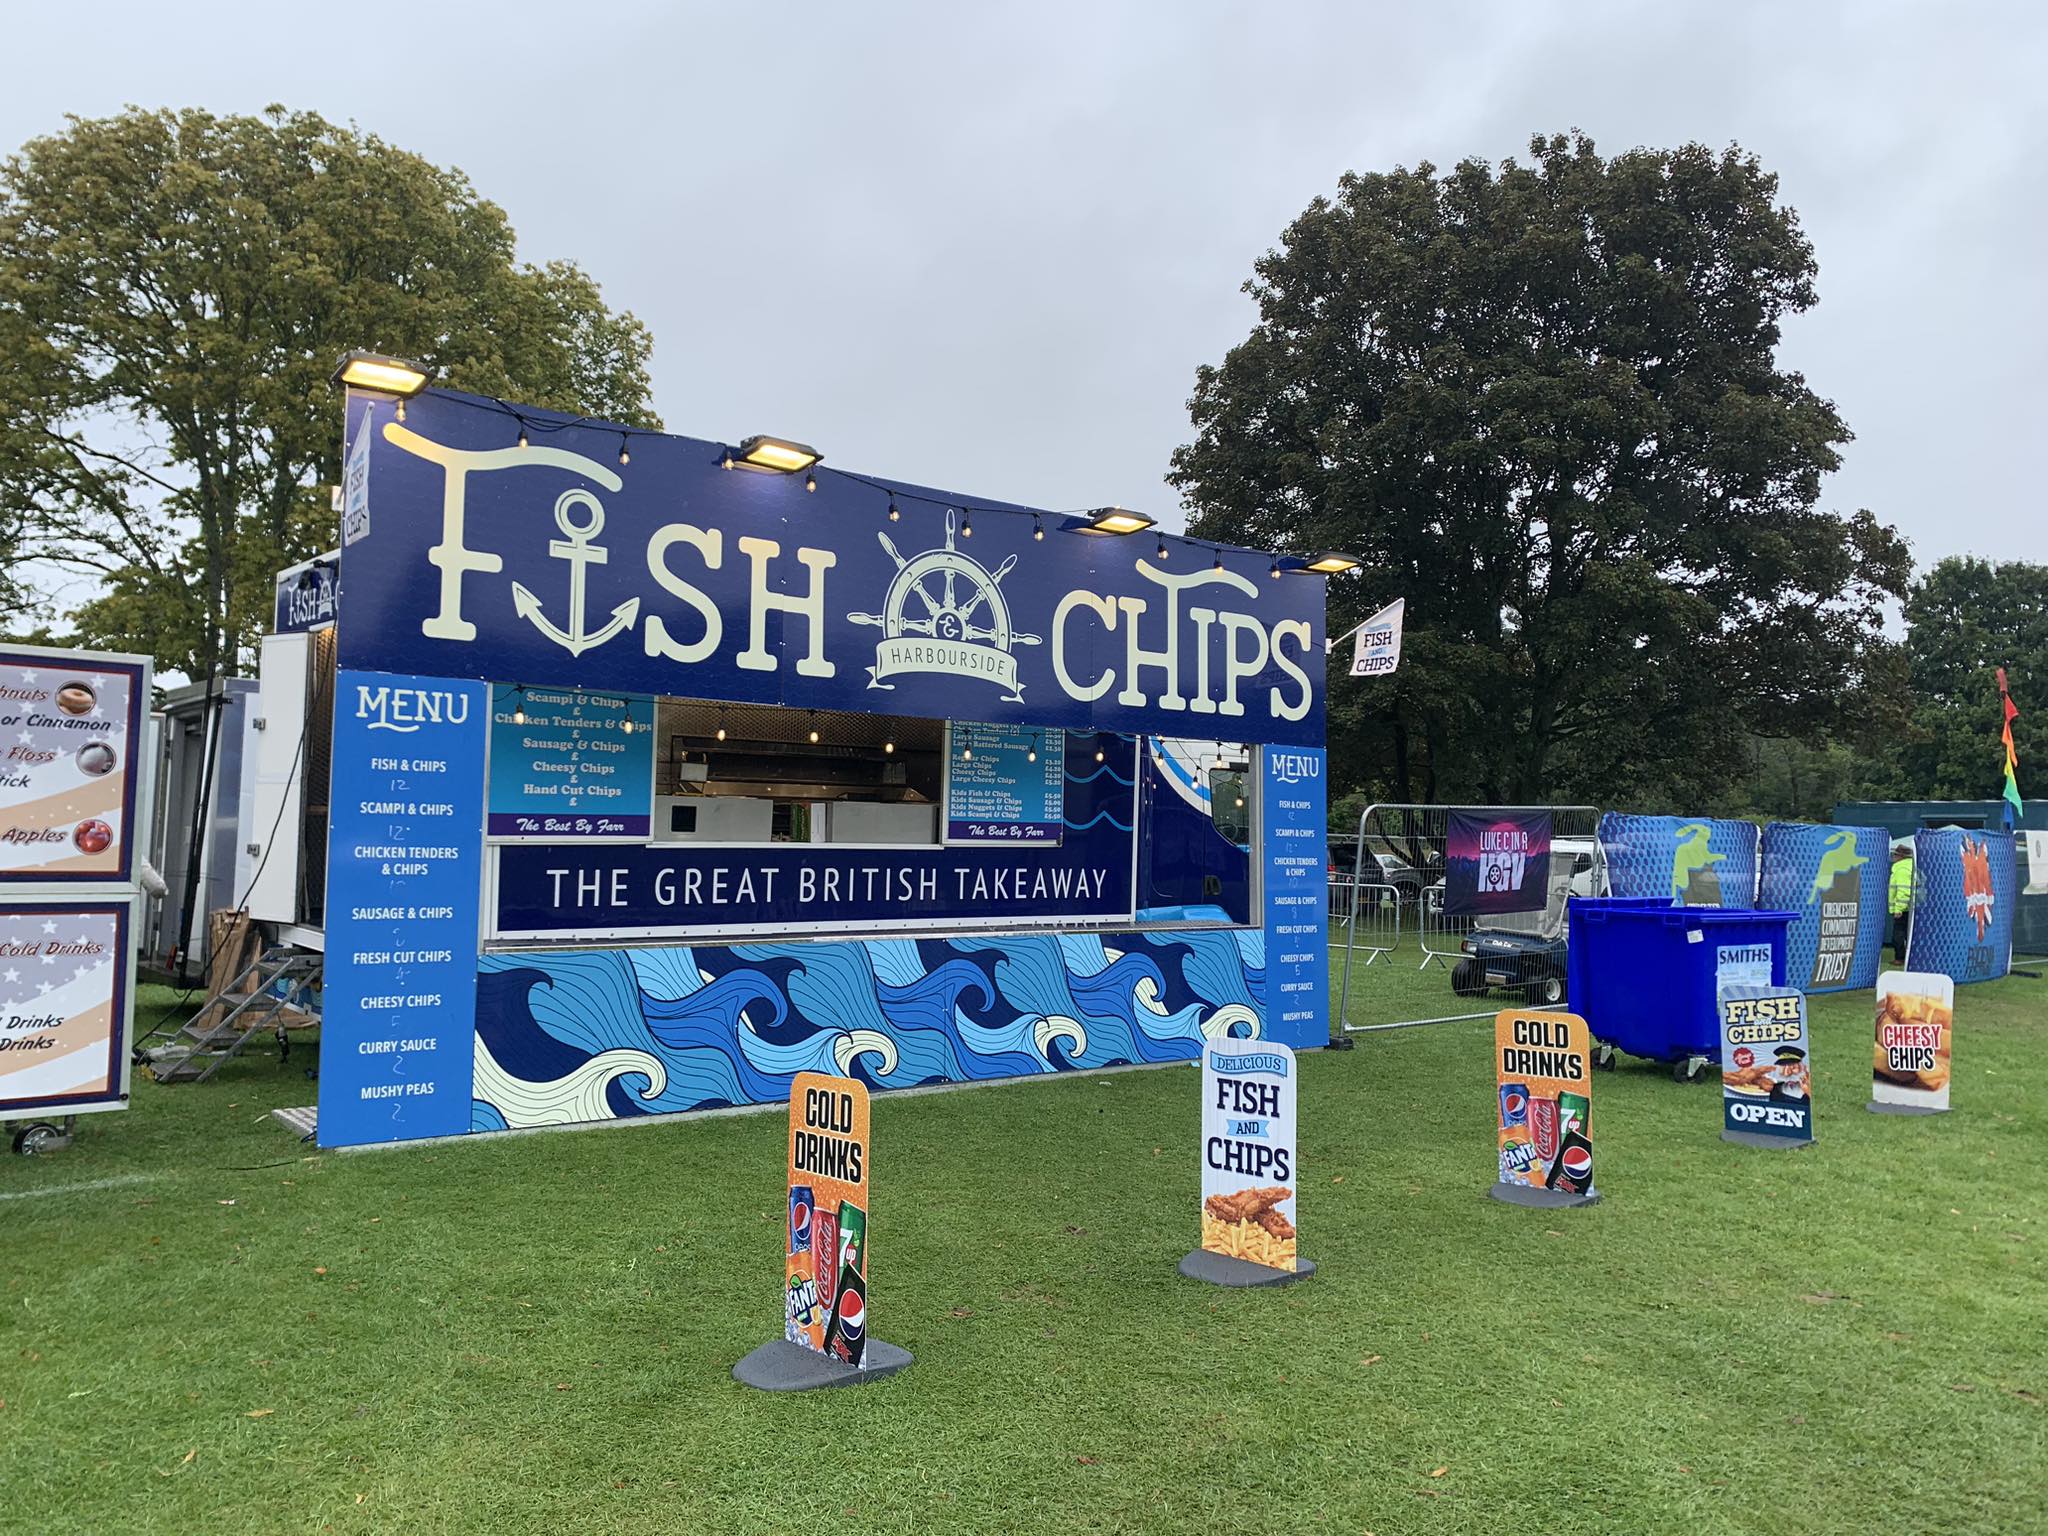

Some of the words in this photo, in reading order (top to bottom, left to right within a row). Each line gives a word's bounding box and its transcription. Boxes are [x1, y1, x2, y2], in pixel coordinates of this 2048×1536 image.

[382, 422, 837, 678] FISH
[939, 615, 959, 638] &
[1052, 558, 1312, 721] CHIPS
[1364, 631, 1392, 648] FISH
[891, 648, 1006, 675] HARBOURSIDE
[1356, 656, 1395, 672] CHIPS
[526, 691, 573, 705] Scampi
[576, 693, 588, 705] &
[591, 695, 626, 709] Chips
[355, 685, 468, 733] MENU
[1, 715, 21, 726] or
[27, 714, 111, 731] Cinnamon
[494, 713, 549, 726] Chken
[552, 716, 602, 729] Tenders
[604, 718, 616, 729] &
[618, 719, 652, 732] Cips
[522, 737, 574, 752] Sausage
[577, 739, 588, 750] &
[591, 740, 626, 753] Chips
[8, 746, 56, 762] Floss
[981, 755, 999, 763] Chips
[371, 758, 397, 771] FISH
[400, 759, 409, 771] &
[412, 760, 447, 773] CHIPS
[532, 760, 577, 775] Cheesy
[580, 762, 615, 775] Chips
[973, 762, 992, 770] Chips
[977, 769, 996, 777] Chips
[1272, 754, 1319, 783] MENU
[997, 777, 1016, 785] Chips
[523, 784, 558, 795] Hand
[561, 784, 584, 796] Cut
[587, 786, 622, 798] Chips
[360, 802, 405, 815] SCAMPI
[408, 803, 416, 815] &
[419, 803, 454, 816] CHIPS
[1296, 801, 1311, 809] CHIPS
[516, 818, 540, 832] The
[544, 818, 572, 832] Best
[575, 819, 593, 834] By
[597, 819, 624, 834] Farr
[968, 825, 985, 836] The
[987, 825, 1007, 836] Best
[1010, 826, 1022, 838] By
[1024, 826, 1045, 838] Farr
[1276, 829, 1294, 837] SCAMPI
[1300, 829, 1315, 838] CHIPS
[2, 827, 67, 844] Apples
[1480, 832, 1502, 851] LUKE
[1503, 832, 1509, 850] C
[1511, 832, 1521, 850] IN
[354, 846, 406, 859] CHICKEN
[408, 847, 458, 859] TENDERS
[381, 863, 391, 875] &
[393, 863, 428, 875] CHIPS
[1274, 857, 1296, 865] CHICKEN
[1297, 858, 1318, 866] TENDERS
[1291, 868, 1306, 876] CHIPS
[1478, 853, 1526, 892] HGV
[547, 869, 629, 908] THE
[655, 868, 779, 905] GREAT
[799, 867, 937, 902] BRITISH
[954, 867, 1108, 900] TAKEAWAY
[1275, 897, 1297, 905] SAUSAGE
[1303, 897, 1317, 905] CHIPS
[352, 907, 404, 920] SAUSAGE
[407, 907, 416, 919] &
[419, 906, 453, 919] CHIPS
[1276, 926, 1292, 934] FRESH
[1293, 925, 1302, 933] CUT
[1303, 925, 1317, 933] CHIPS
[0, 942, 41, 957] Cold
[46, 941, 103, 956] Drinks
[1720, 948, 1769, 964] SMITHS
[353, 952, 390, 965] FRESH
[393, 951, 415, 963] CUT
[418, 950, 452, 963] CHIPS
[1280, 954, 1299, 963] CHEESY
[1300, 954, 1314, 962] CHIPS
[1816, 953, 1852, 981] TRUST
[1281, 983, 1297, 992] CURRY
[1298, 982, 1313, 991] SAUCE
[360, 996, 404, 1009] CHEESY
[406, 994, 441, 1007] CHIPS
[1283, 1012, 1300, 1021] MUSHY
[1301, 1011, 1313, 1020] PEAS
[1727, 997, 1800, 1023] FISH
[6, 1015, 64, 1029] Drinks
[1514, 1020, 1568, 1048] COLD
[1728, 1023, 1800, 1043] CHIPS
[1884, 1025, 1941, 1048] CHEESY
[0, 1036, 55, 1050] Drinks
[358, 1041, 398, 1055] CURRY
[400, 1038, 437, 1052] SAUCE
[1217, 1056, 1281, 1071] DELICIOUS
[1503, 1048, 1582, 1080] DRINKS
[1889, 1047, 1934, 1070] CHIPS
[361, 1084, 404, 1099] MUSHY
[406, 1082, 435, 1096] PEAS
[1217, 1078, 1280, 1118] FISH
[805, 1088, 852, 1134] COLD
[1730, 1103, 1805, 1128] OPEN
[1236, 1121, 1259, 1135] AND
[1561, 1108, 1576, 1133] 7
[794, 1131, 862, 1184] DRINKS
[1207, 1137, 1290, 1181] CHIPS
[840, 1228, 853, 1267] 7
